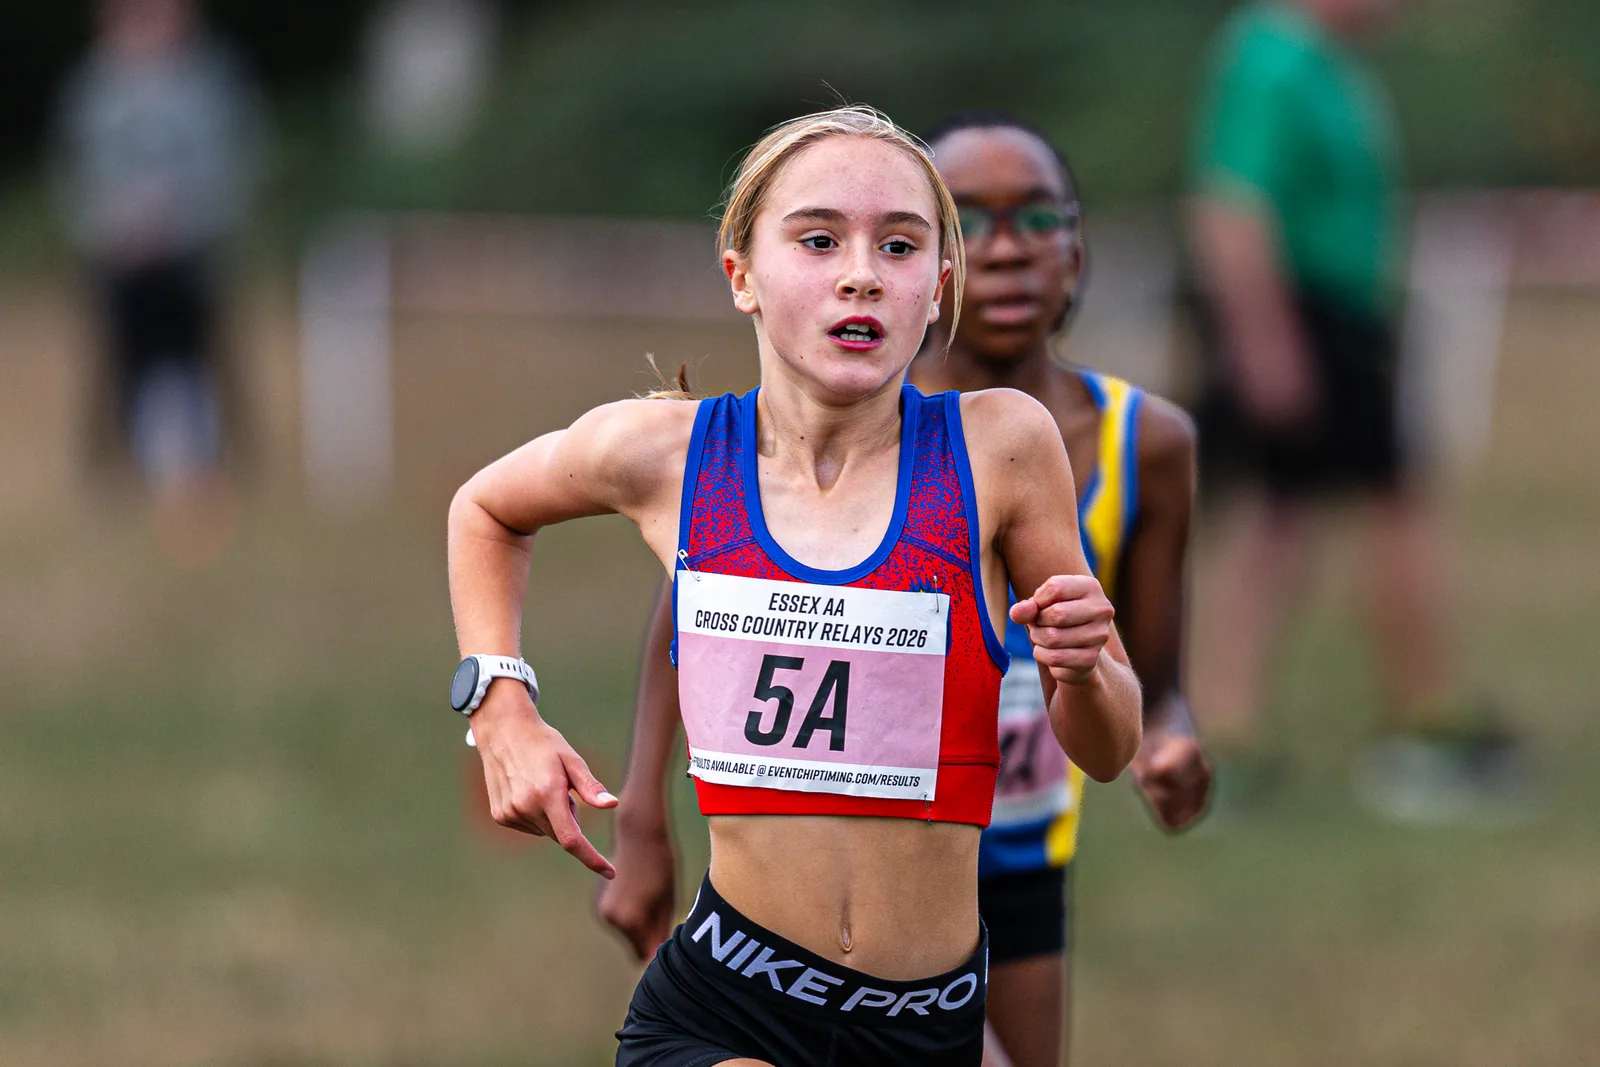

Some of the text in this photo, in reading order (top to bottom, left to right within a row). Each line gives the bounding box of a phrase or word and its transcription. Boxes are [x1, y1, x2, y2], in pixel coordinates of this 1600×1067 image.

[768, 592, 845, 617] ESSEX AA
[695, 609, 928, 648] CROSS COUNTRY RELAYS 2026
[743, 653, 851, 752] 5A
[710, 759, 756, 775] AVAILABLE
[756, 764, 767, 777] @
[767, 765, 921, 788] EVENTCHIPTIMING.COM/RESULTS
[691, 910, 978, 1017] NIKE PRO
